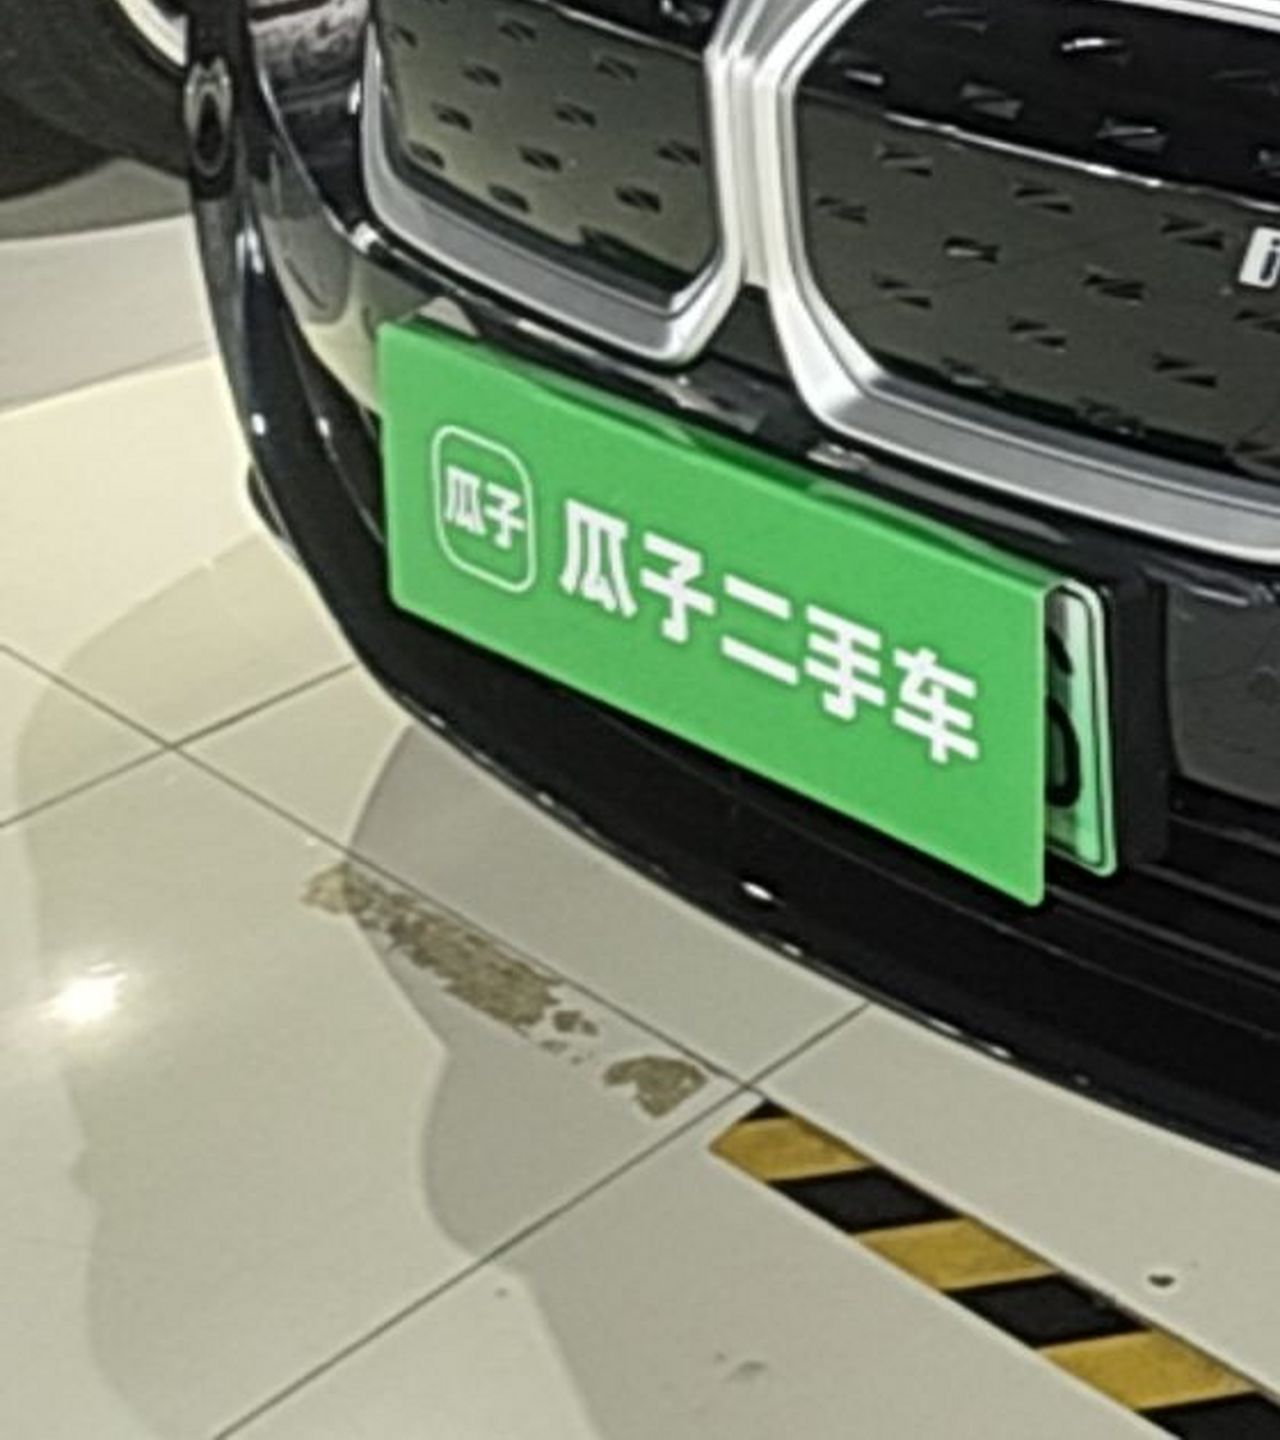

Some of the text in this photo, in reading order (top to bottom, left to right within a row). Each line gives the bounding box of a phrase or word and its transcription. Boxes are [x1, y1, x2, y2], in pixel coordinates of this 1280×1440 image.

[444, 464, 526, 549] 瓜子
[559, 498, 980, 764] 瓜子二手车
